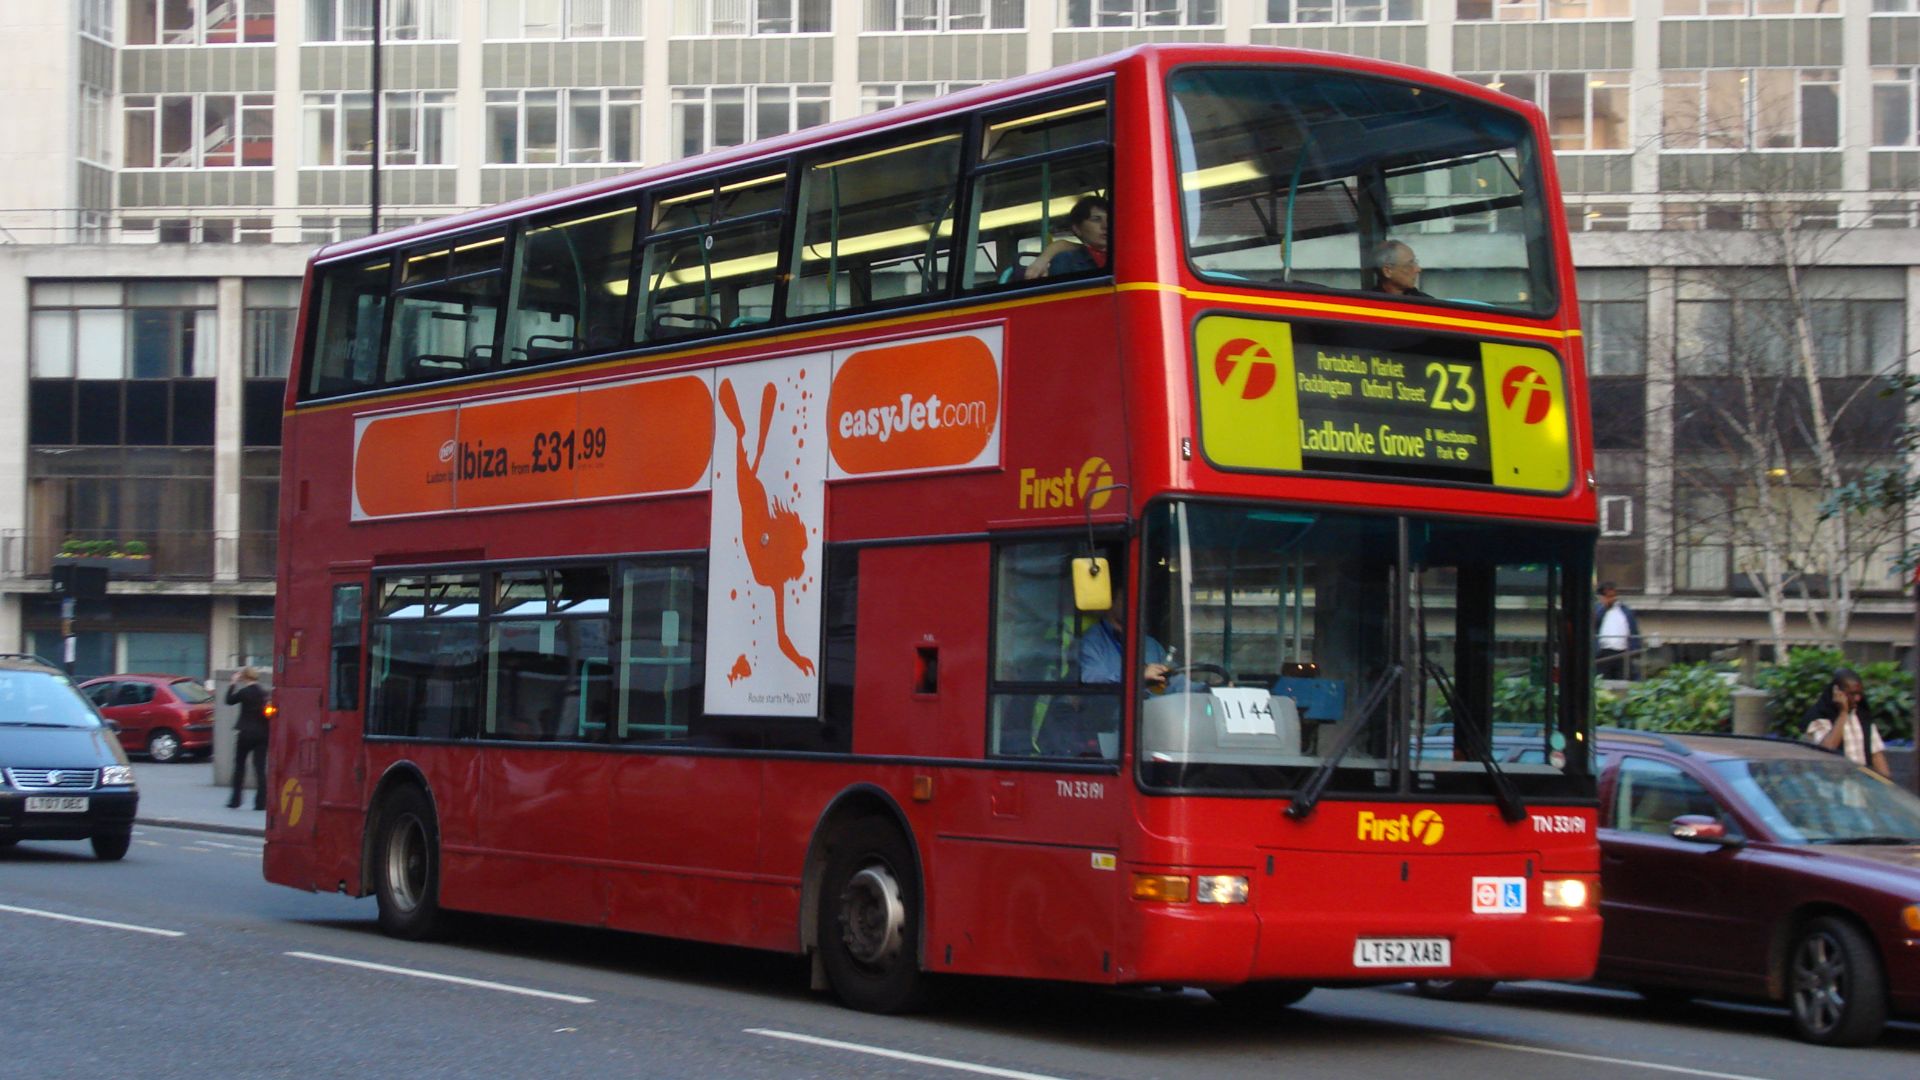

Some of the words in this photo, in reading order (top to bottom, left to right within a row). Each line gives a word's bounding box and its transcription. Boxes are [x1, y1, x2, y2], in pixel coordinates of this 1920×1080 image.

[1317, 351, 1368, 375] Portobello
[1370, 357, 1405, 378] Market
[1298, 372, 1353, 399] Paddington
[1360, 378, 1394, 399] Oxford
[1396, 381, 1427, 402] Street
[1425, 362, 1476, 412] 23
[838, 393, 987, 443] easyJet.com
[457, 439, 508, 481] Ibiza
[531, 426, 607, 473] £31.99
[1300, 418, 1376, 454] Ladbroke
[1378, 424, 1425, 458] Grove
[1019, 467, 1074, 509] First
[1223, 701, 1273, 721] 1144
[1056, 779, 1073, 797] TN
[1074, 780, 1104, 799] 33191
[1358, 811, 1410, 843] First
[1531, 815, 1553, 833] TN
[1361, 942, 1406, 962] LT52
[1410, 942, 1443, 962] XAB
